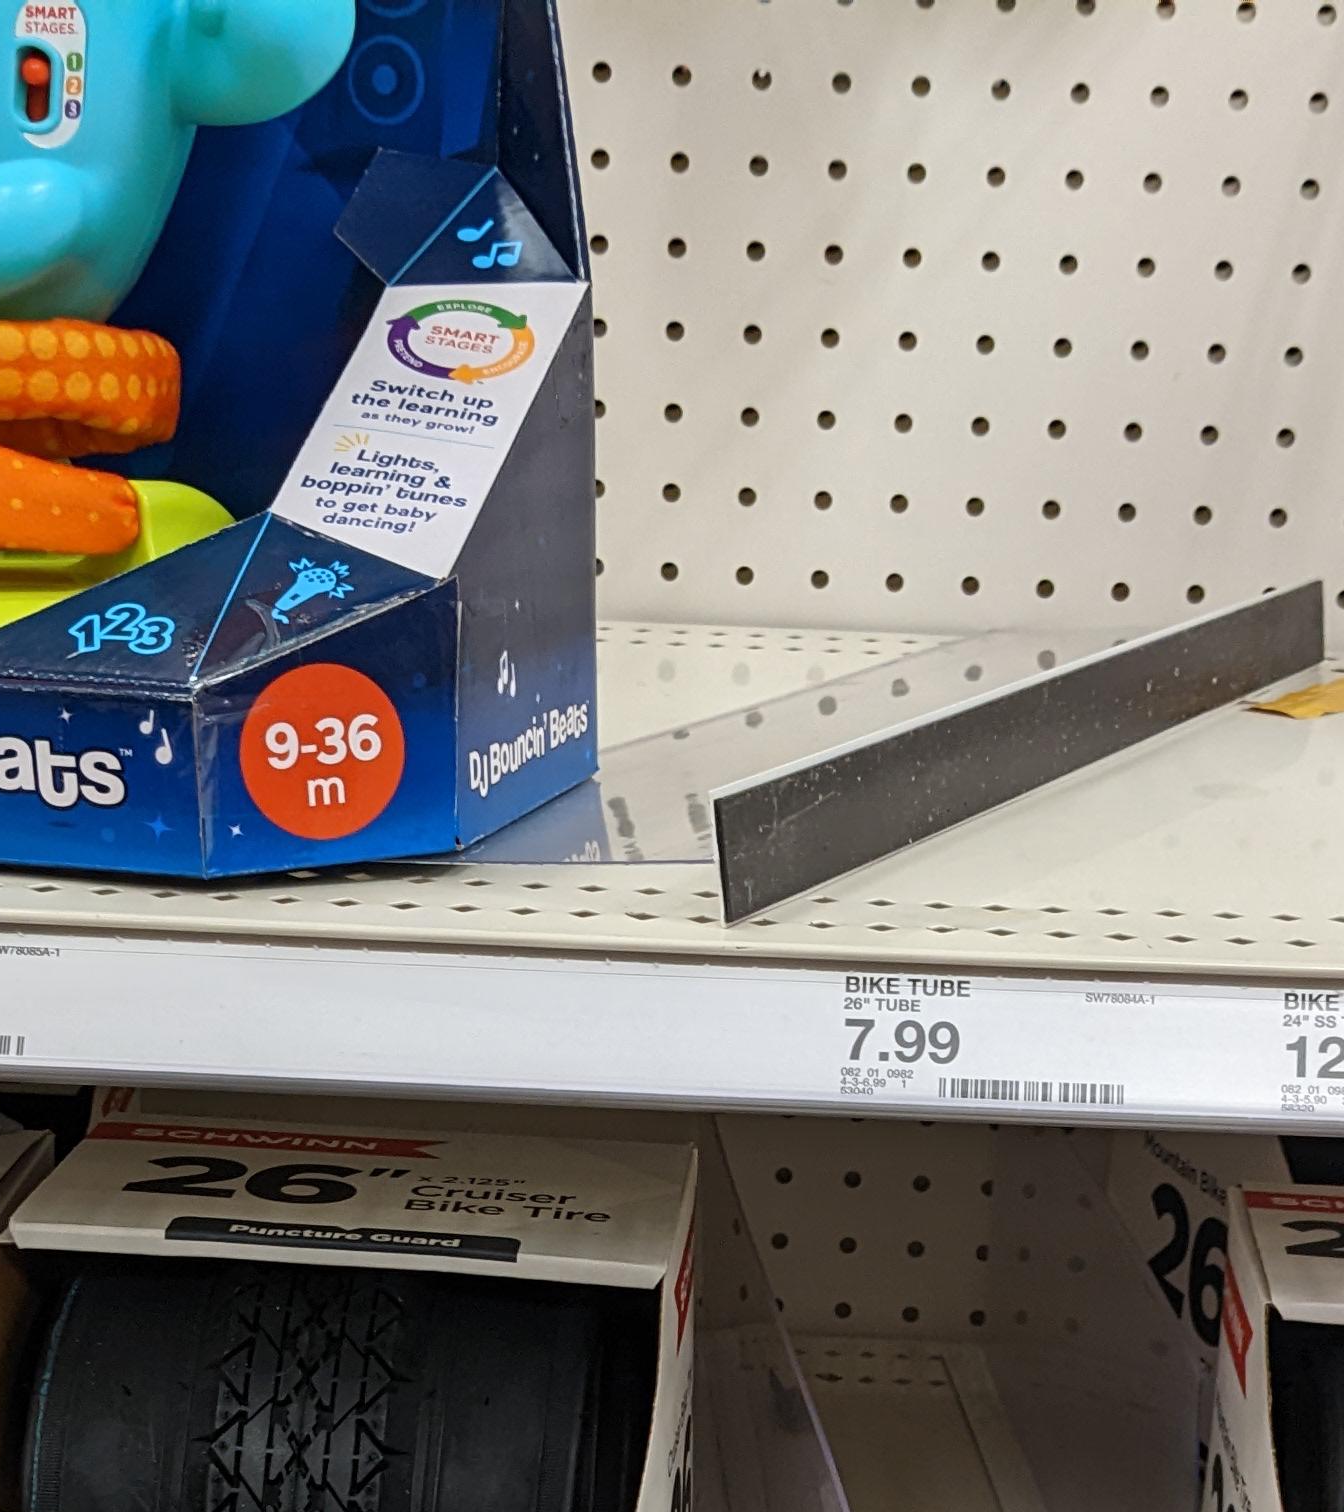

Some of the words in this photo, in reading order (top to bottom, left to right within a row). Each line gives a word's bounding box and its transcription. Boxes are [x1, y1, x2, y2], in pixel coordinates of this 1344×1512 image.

[26, 5, 76, 19] SMART
[25, 21, 75, 34] STAGES
[425, 336, 494, 354] STAGES
[430, 325, 500, 344] SMART
[370, 379, 455, 401] Switch
[462, 394, 494, 409] up
[351, 393, 391, 407] the
[398, 398, 499, 426] learning
[361, 411, 380, 420] as
[384, 413, 422, 428] they
[425, 420, 475, 435] grow!
[357, 449, 440, 473] Lights,
[330, 462, 427, 488] learning
[434, 476, 452, 489] &
[396, 484, 468, 507] tunes
[316, 496, 336, 509] to
[343, 498, 378, 513] get
[384, 503, 438, 522] baby
[322, 512, 416, 534] dancing!
[69, 602, 175, 655] 123
[264, 712, 384, 771] 9-36
[306, 774, 347, 807] m
[844, 975, 900, 995] BIKE
[907, 978, 971, 998] TUBE
[1284, 992, 1340, 1012] BIKE
[844, 1018, 961, 1065] 7.99
